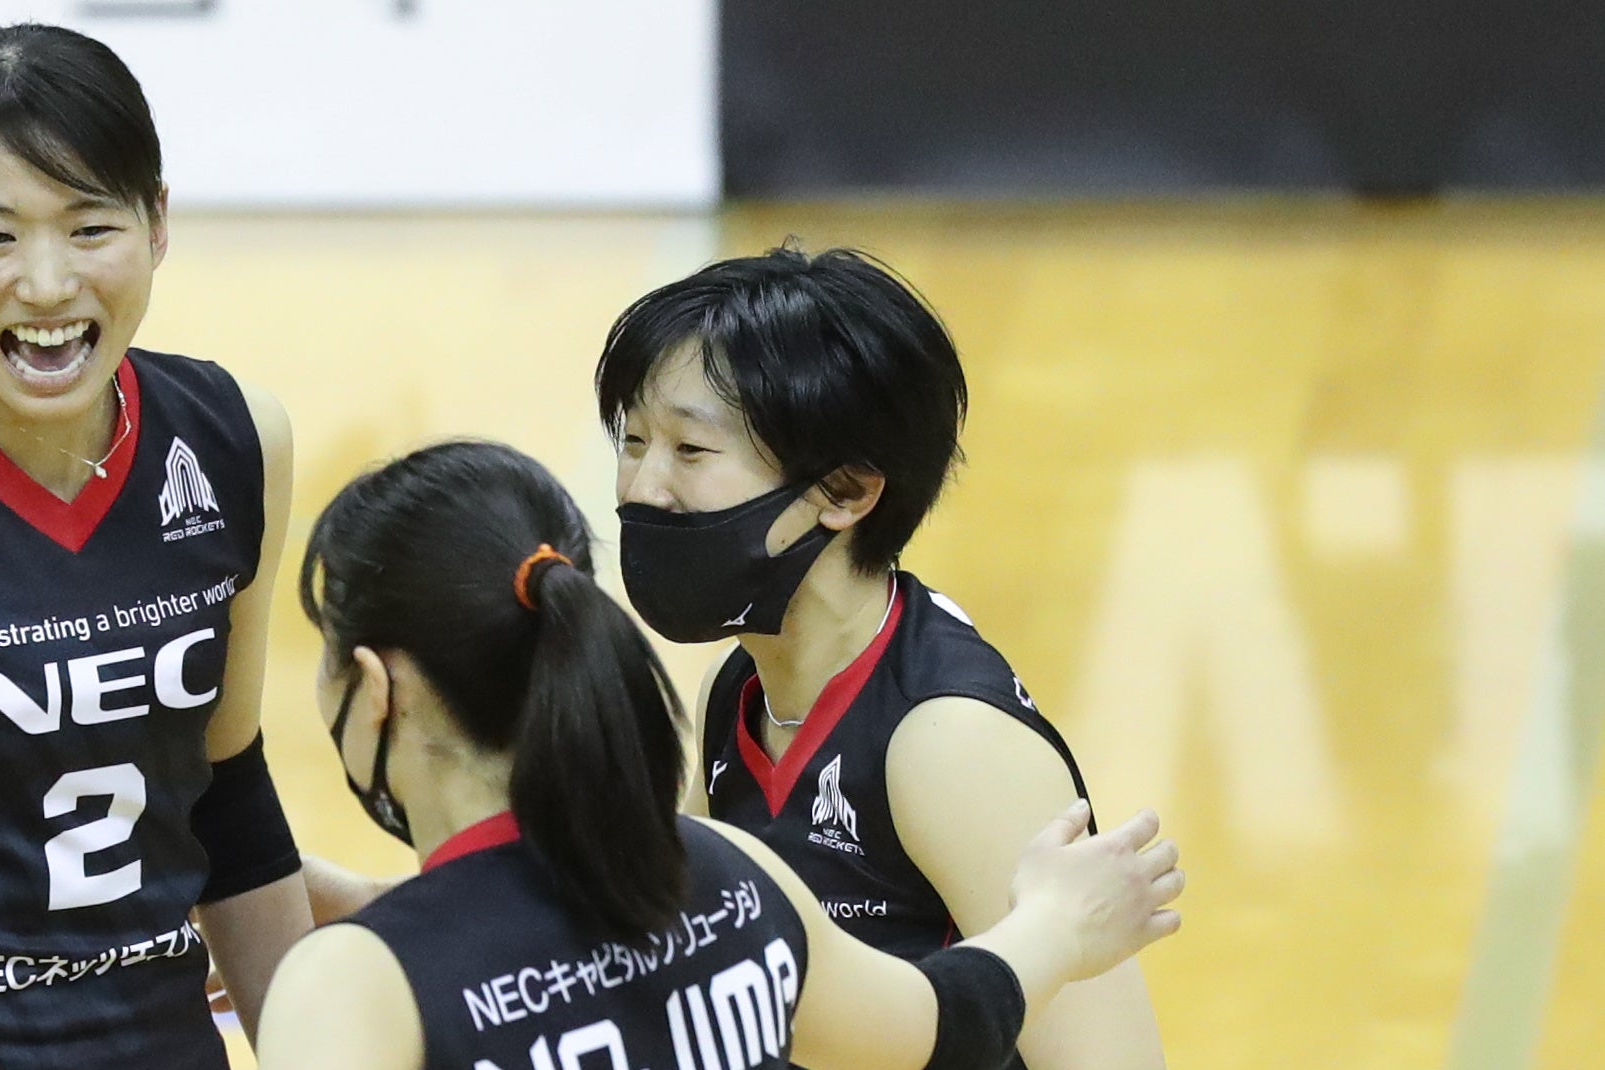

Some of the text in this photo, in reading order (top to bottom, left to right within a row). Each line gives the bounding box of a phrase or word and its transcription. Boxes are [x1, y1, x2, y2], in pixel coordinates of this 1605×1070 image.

[97, 615, 110, 631] a
[113, 591, 198, 627] brighter
[43, 763, 147, 911] 2
